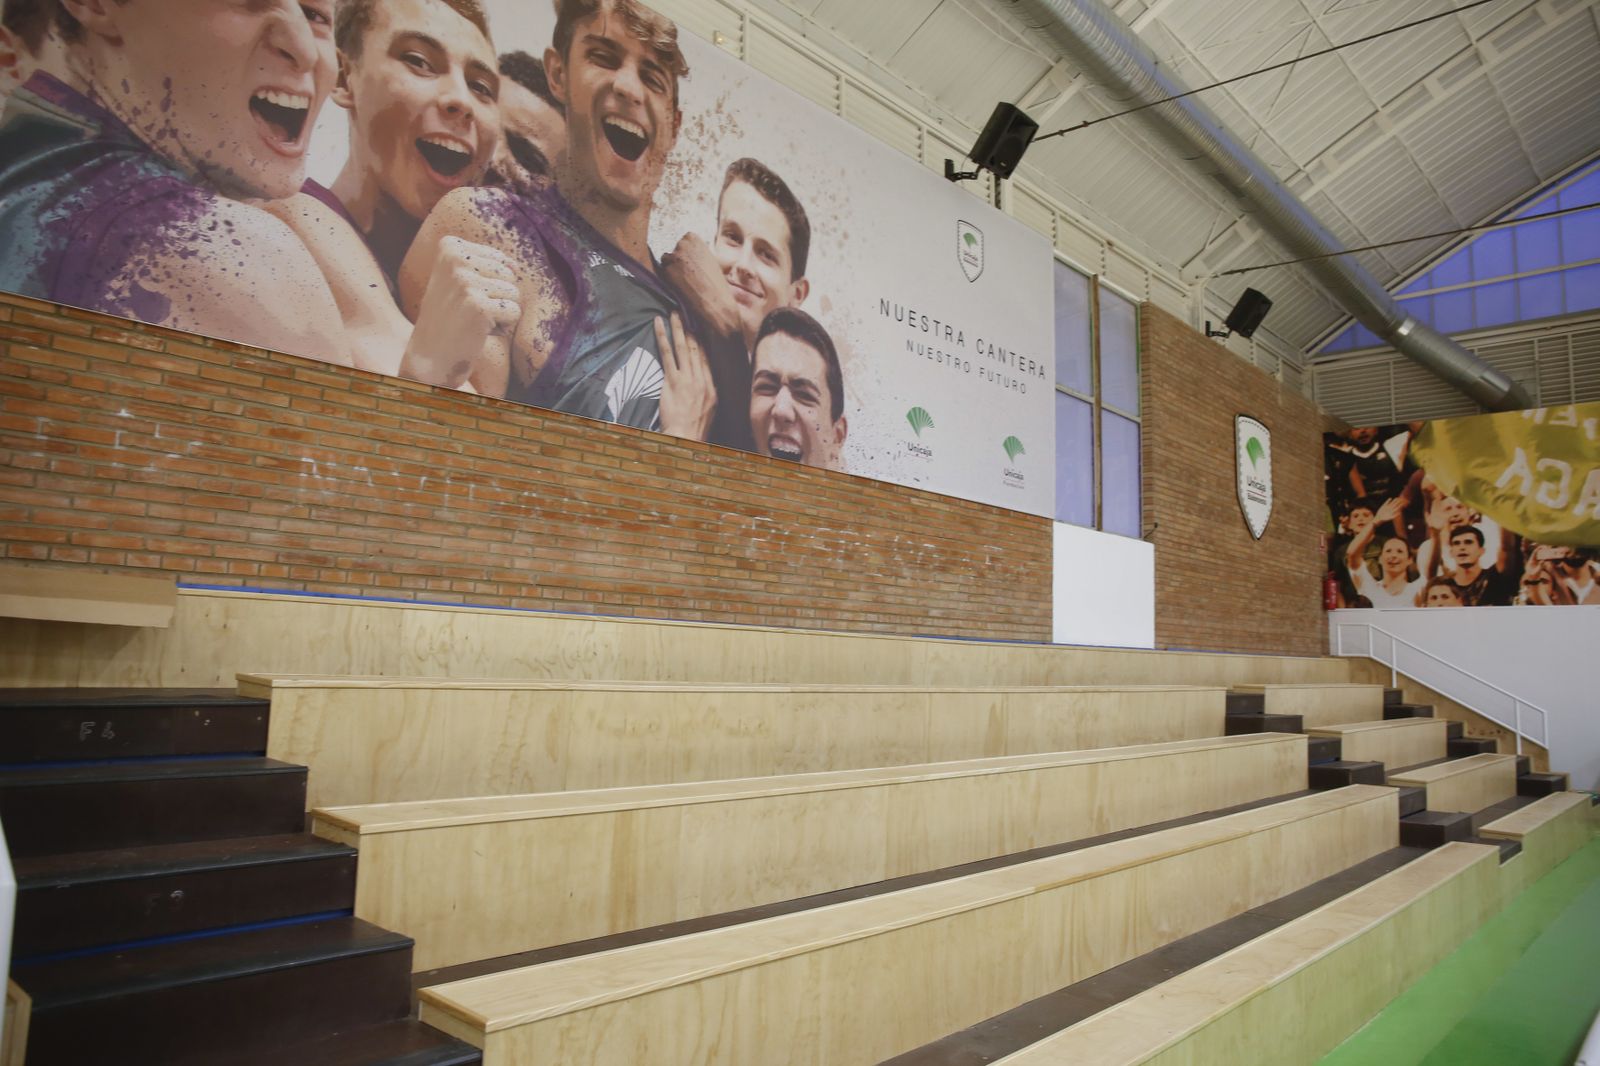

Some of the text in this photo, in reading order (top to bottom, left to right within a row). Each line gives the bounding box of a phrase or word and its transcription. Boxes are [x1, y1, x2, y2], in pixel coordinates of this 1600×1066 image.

[880, 298, 1046, 380] NUESTRA CANTERA
[906, 339, 1027, 394] NUESTRO FUTURO
